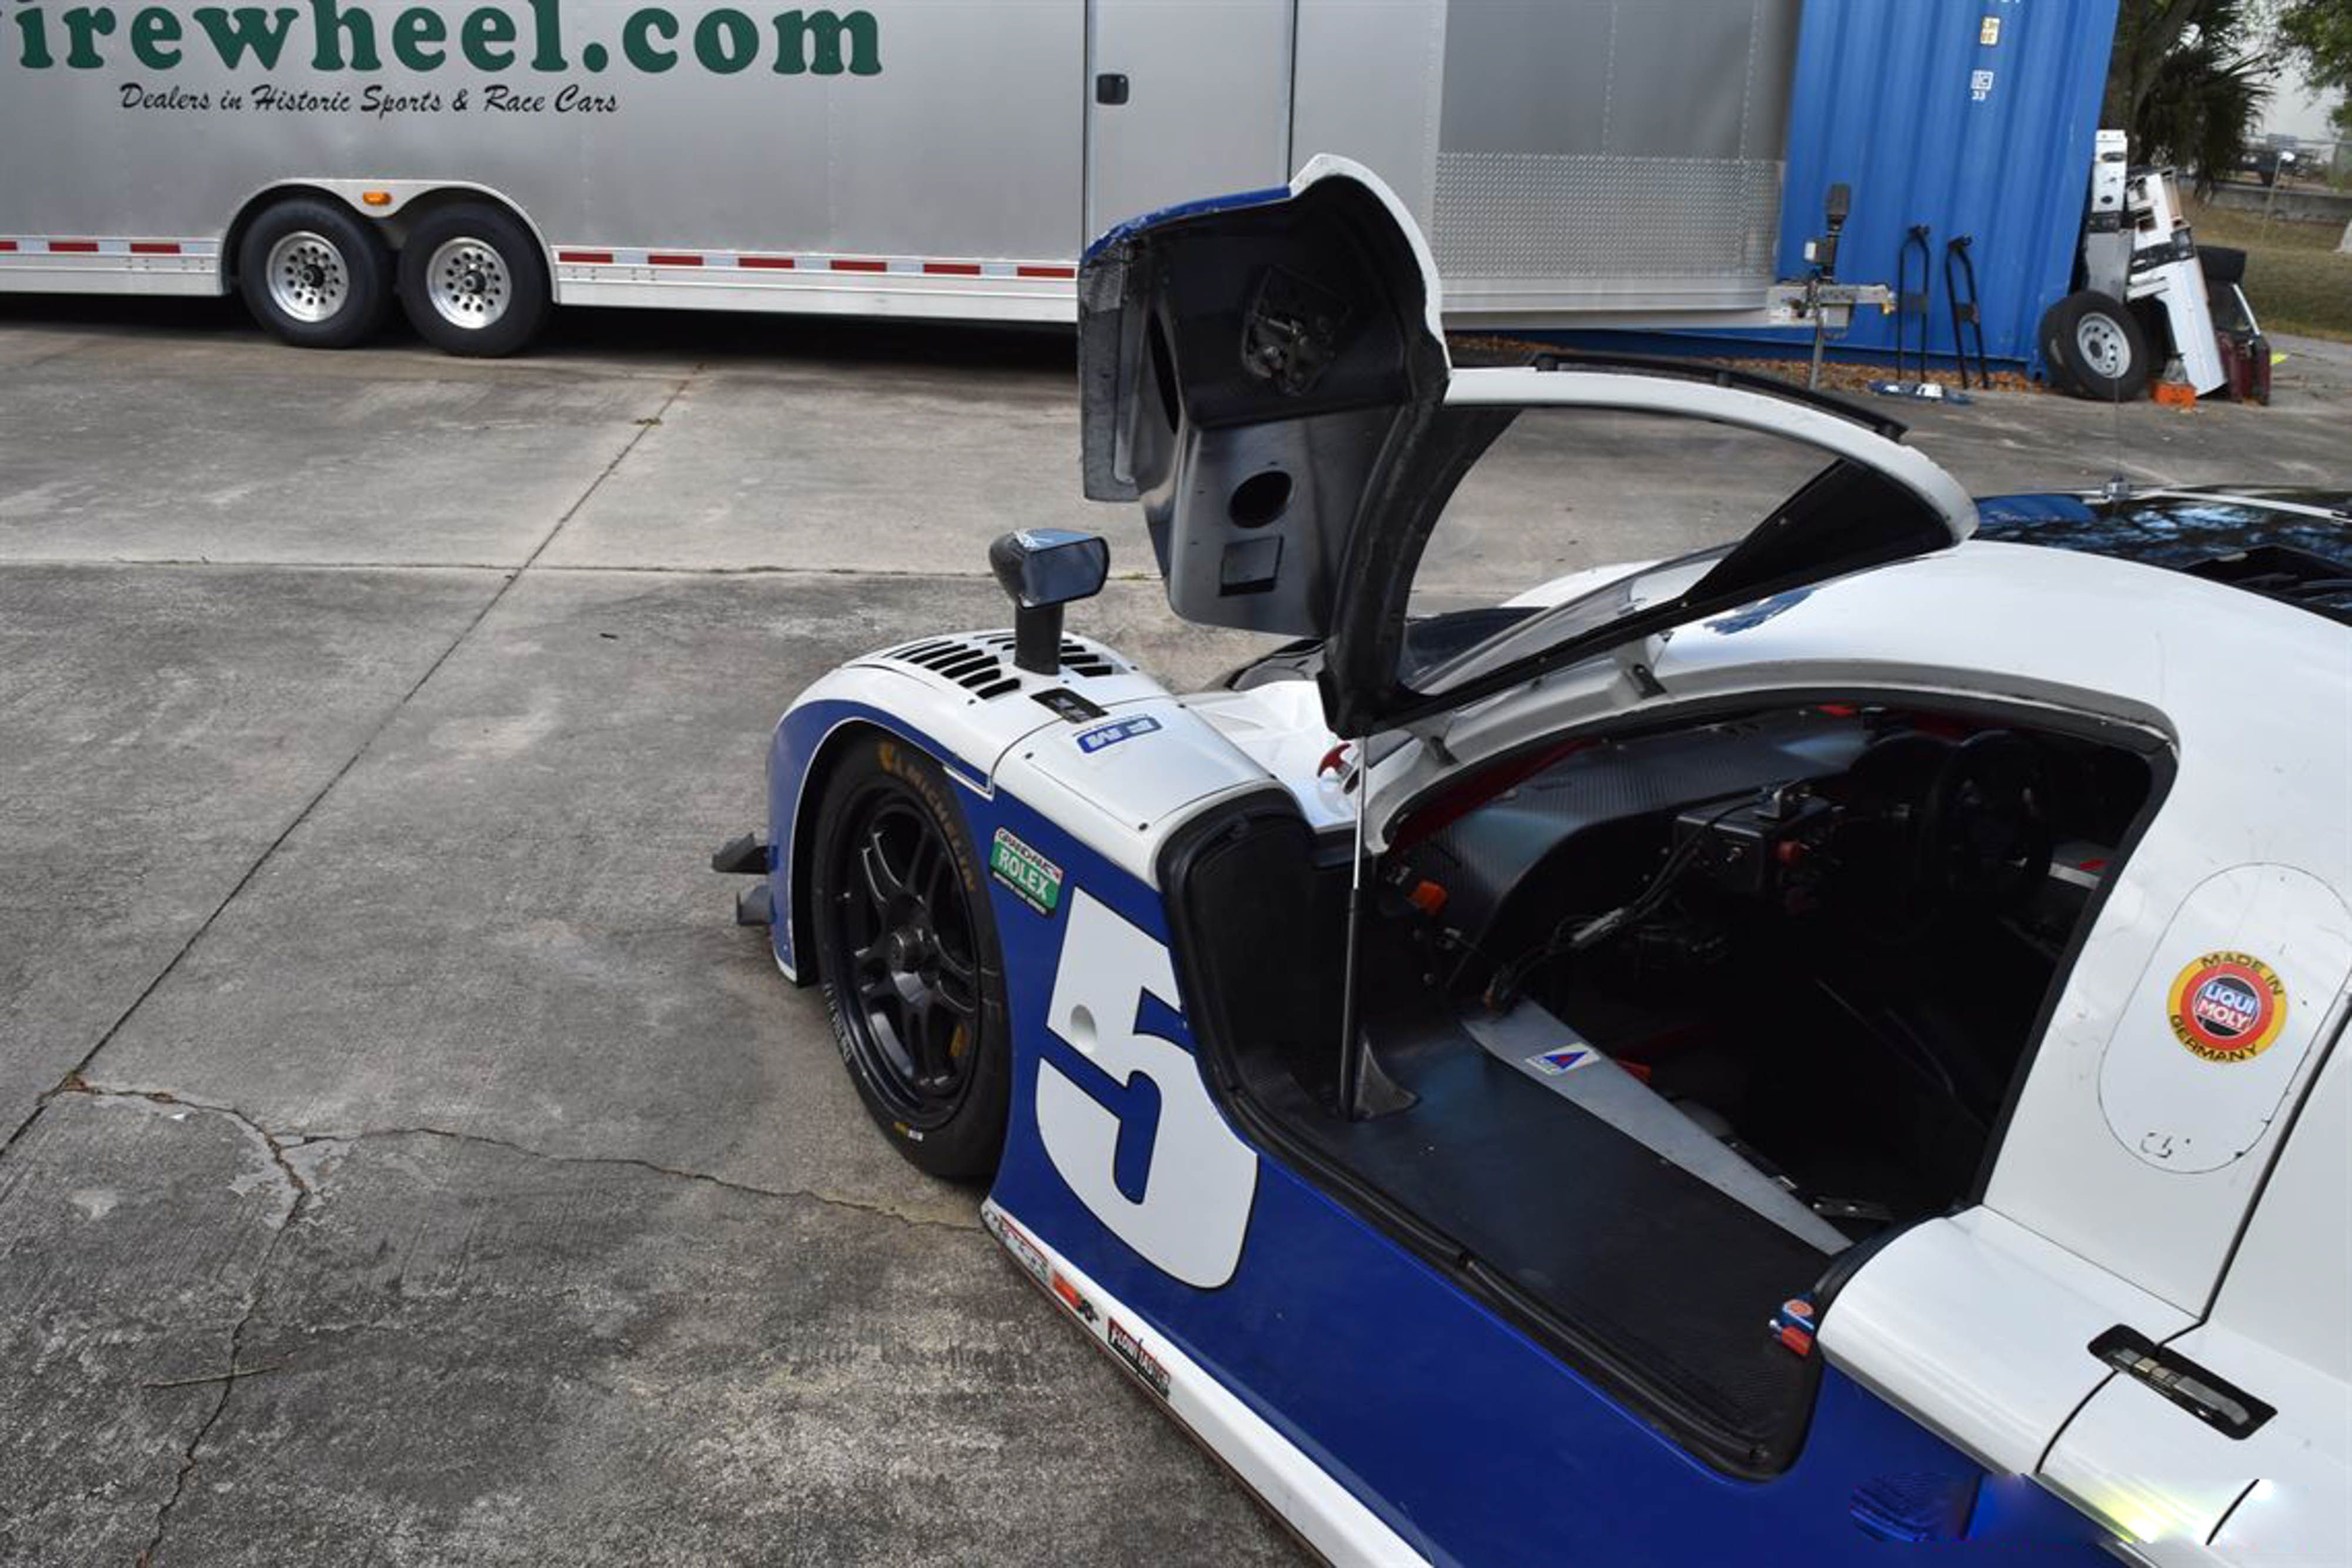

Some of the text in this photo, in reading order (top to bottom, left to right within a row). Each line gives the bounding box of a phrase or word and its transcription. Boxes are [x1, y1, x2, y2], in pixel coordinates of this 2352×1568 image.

[0, 0, 883, 75] irewheel.com
[119, 82, 618, 119] Dealers in Historic Sports & Race Cars
[998, 845, 1050, 900] ROLEX
[2201, 953, 2284, 995] MADE IN
[2198, 998, 2249, 1028] MOLY
[2205, 981, 2257, 1015] LIQUI
[2170, 1015, 2257, 1062] GERMANY
[1035, 886, 1259, 1290] 5
